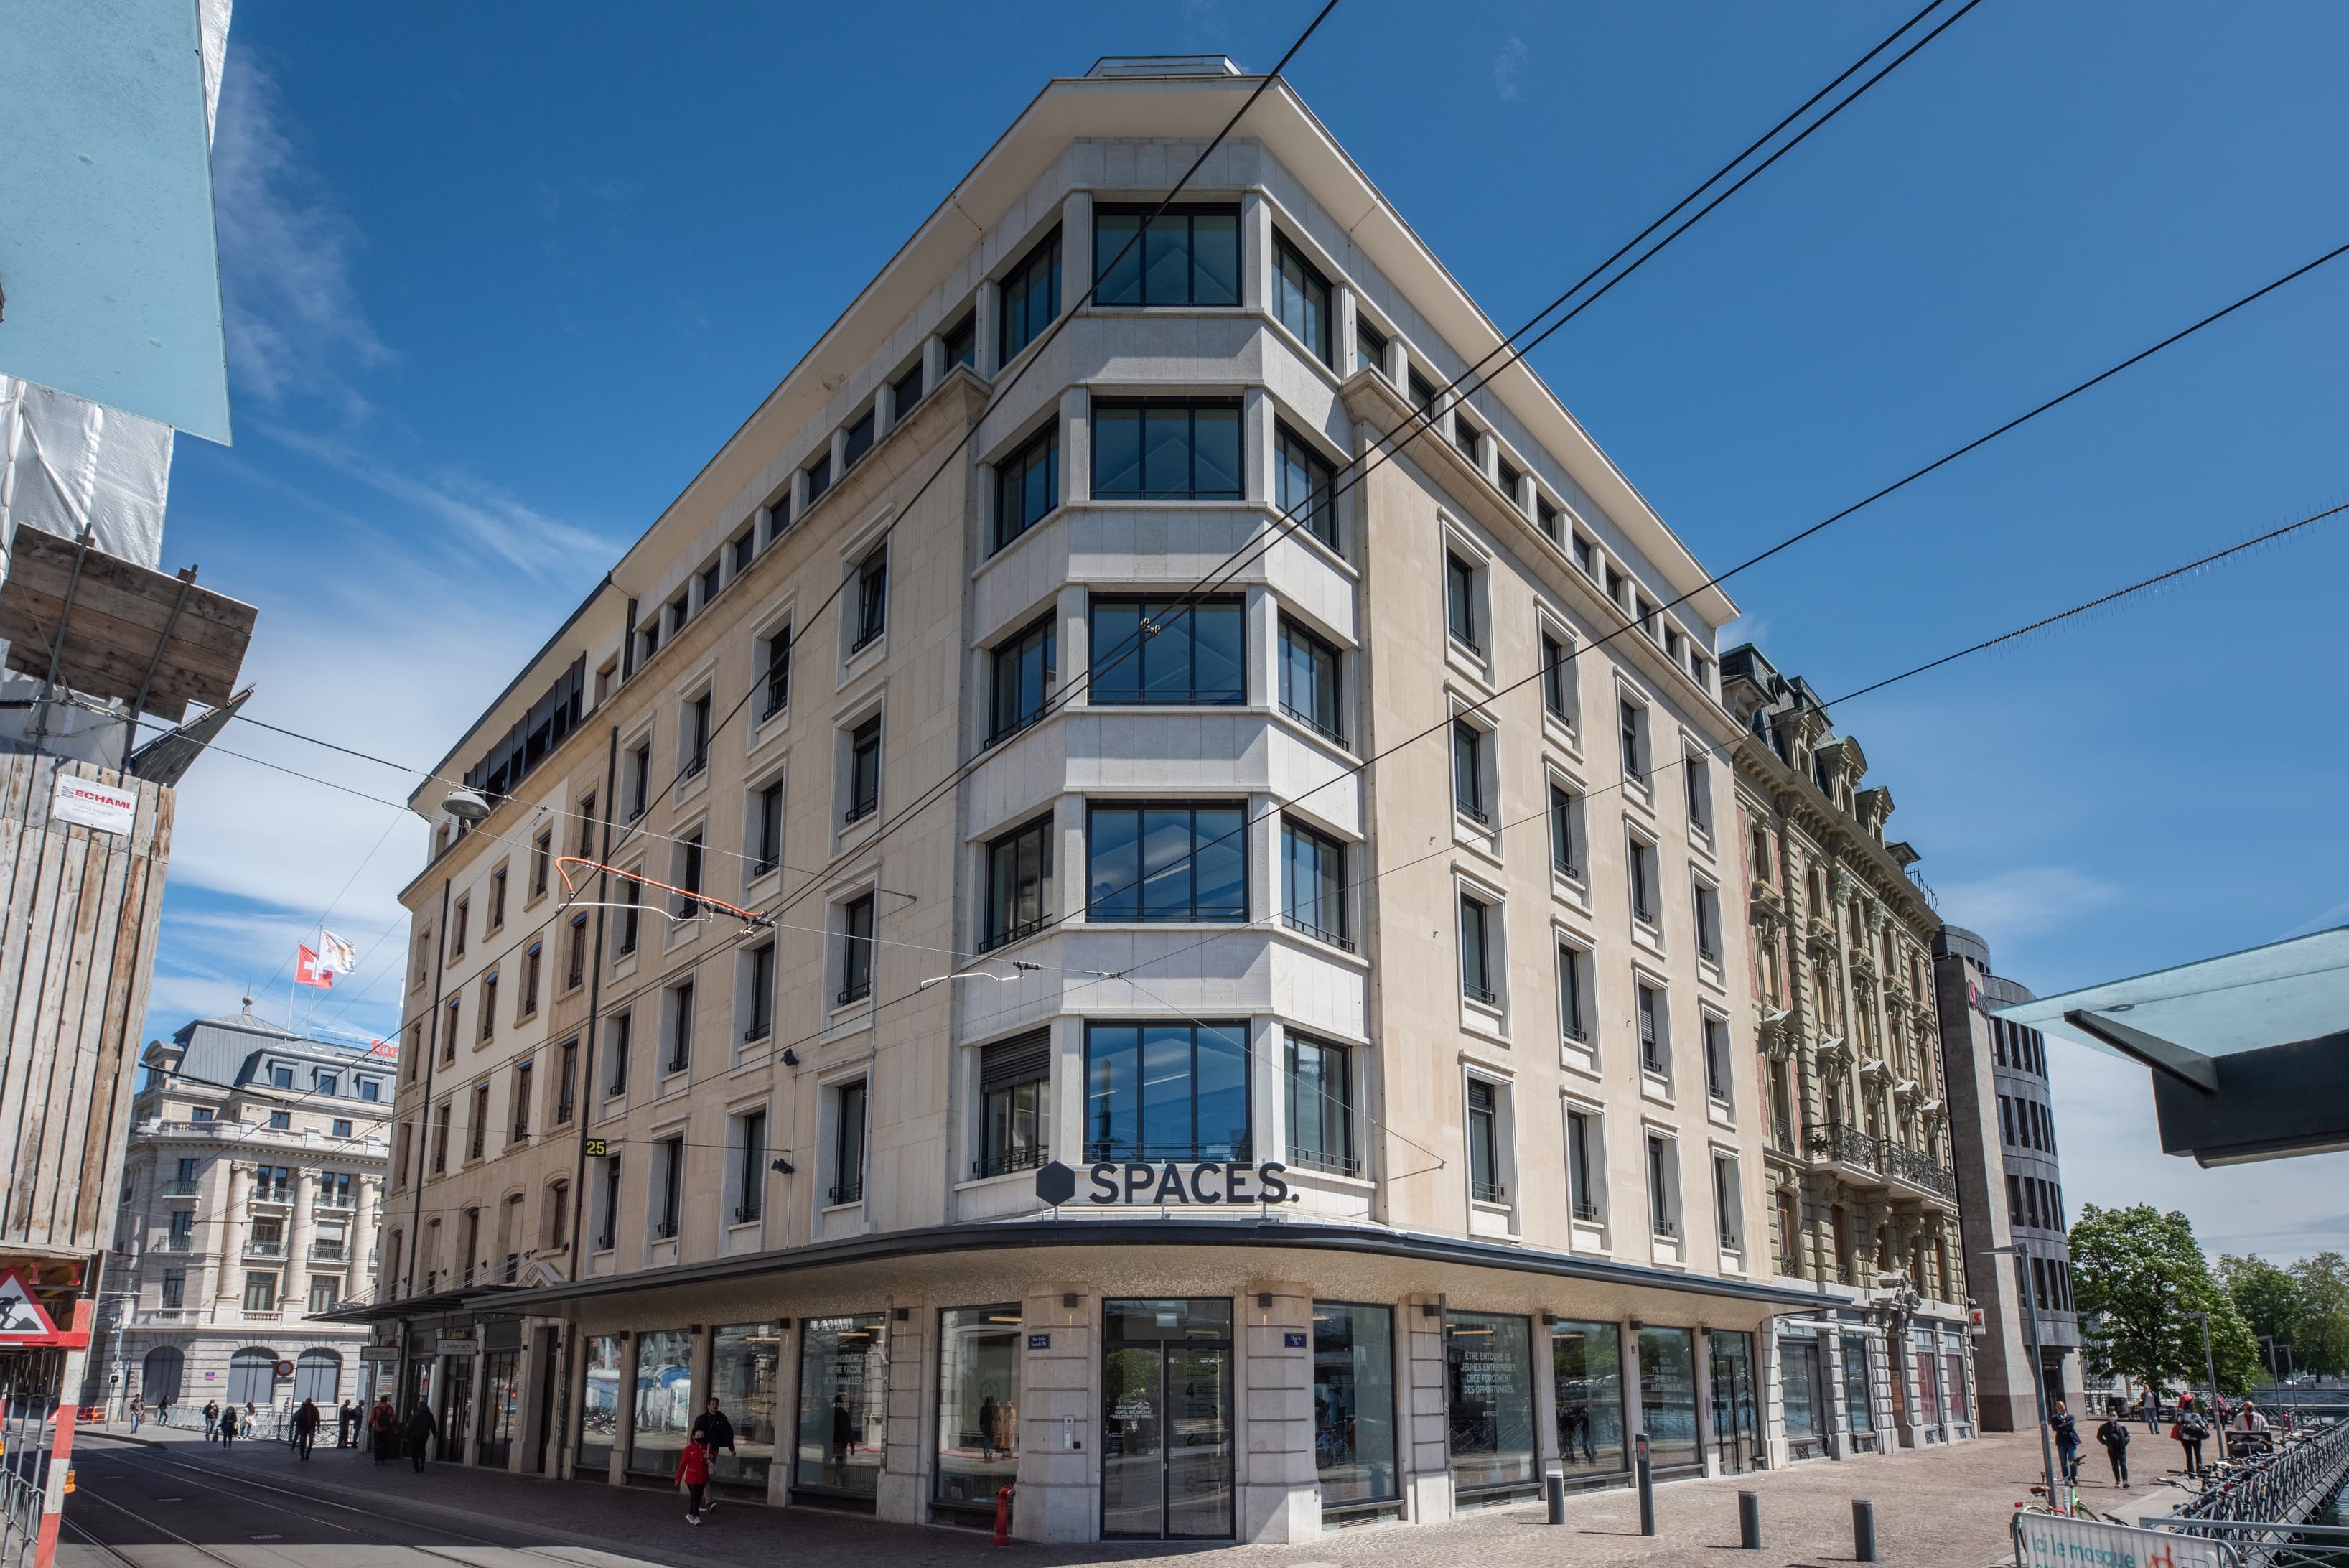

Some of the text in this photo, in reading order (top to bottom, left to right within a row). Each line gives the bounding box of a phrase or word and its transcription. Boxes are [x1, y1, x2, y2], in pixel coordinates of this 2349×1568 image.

[75, 789, 131, 809] ECHAMI
[587, 1141, 605, 1154] 25
[1089, 1162, 1300, 1204] SPACES.
[826, 1366, 843, 1374] VOTRE
[1460, 1363, 1516, 1372] JEUNES ENTREPRISES
[1465, 1385, 1475, 1394] DES
[2031, 1531, 2136, 1568] Ici le masque
